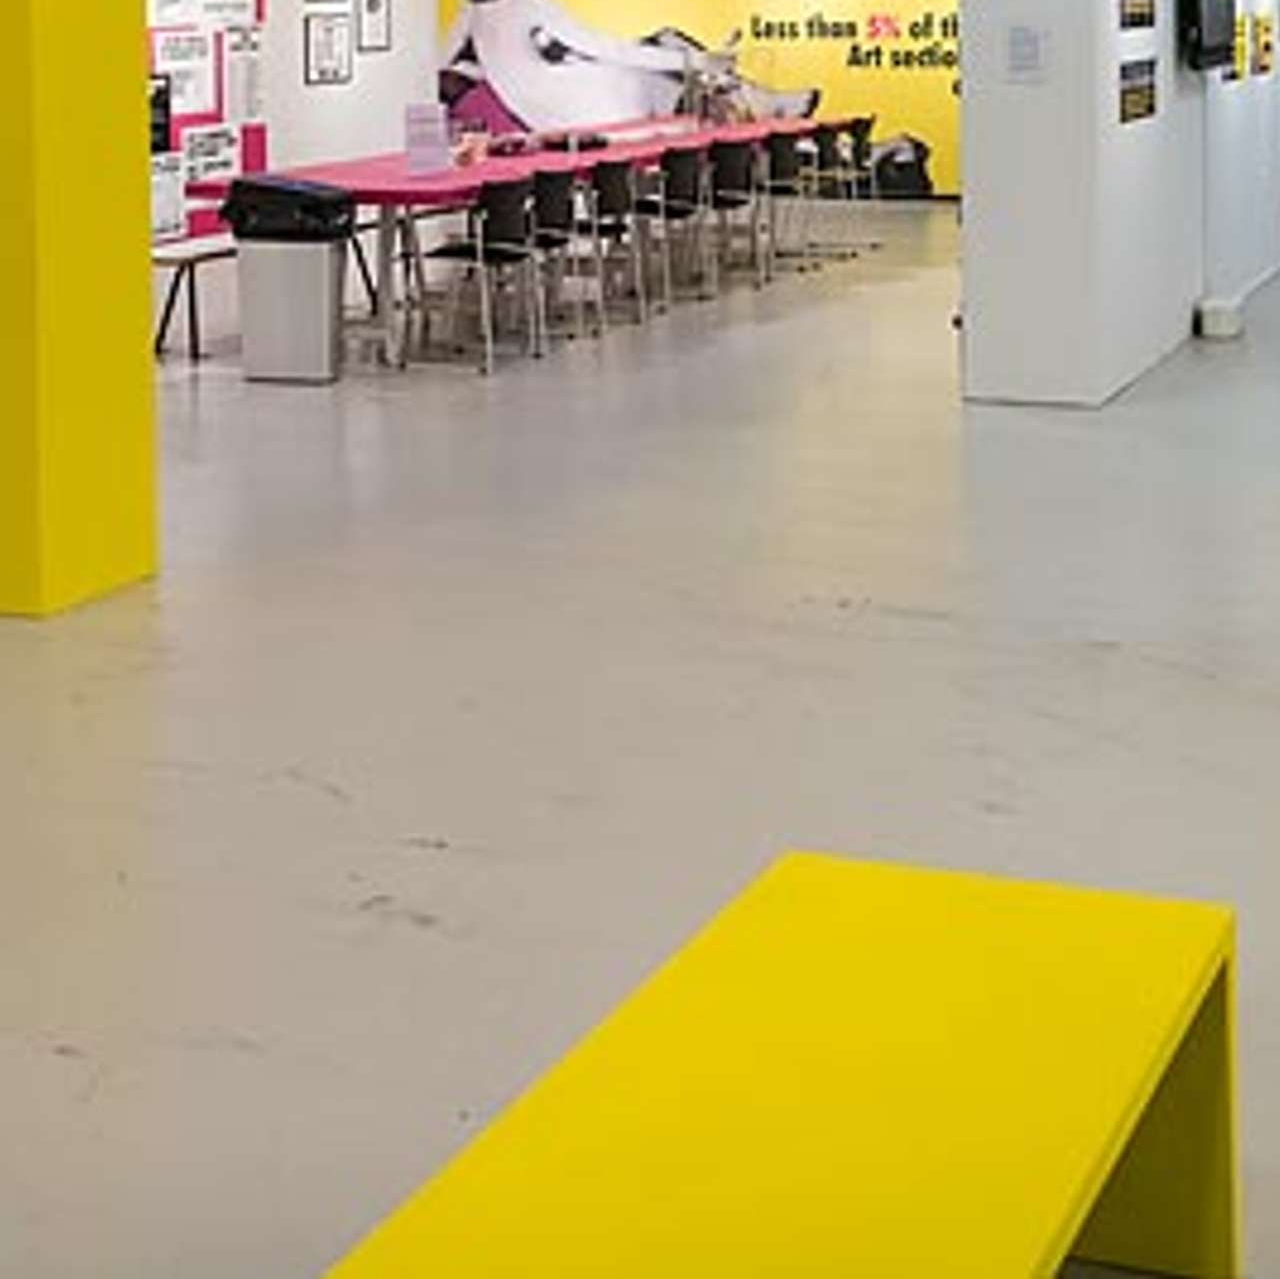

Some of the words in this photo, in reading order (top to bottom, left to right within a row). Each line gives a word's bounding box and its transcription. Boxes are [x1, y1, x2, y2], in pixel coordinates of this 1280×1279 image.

[750, 13, 800, 39] Less
[806, 10, 857, 38] than
[908, 12, 934, 40] of
[846, 43, 882, 67] Art
